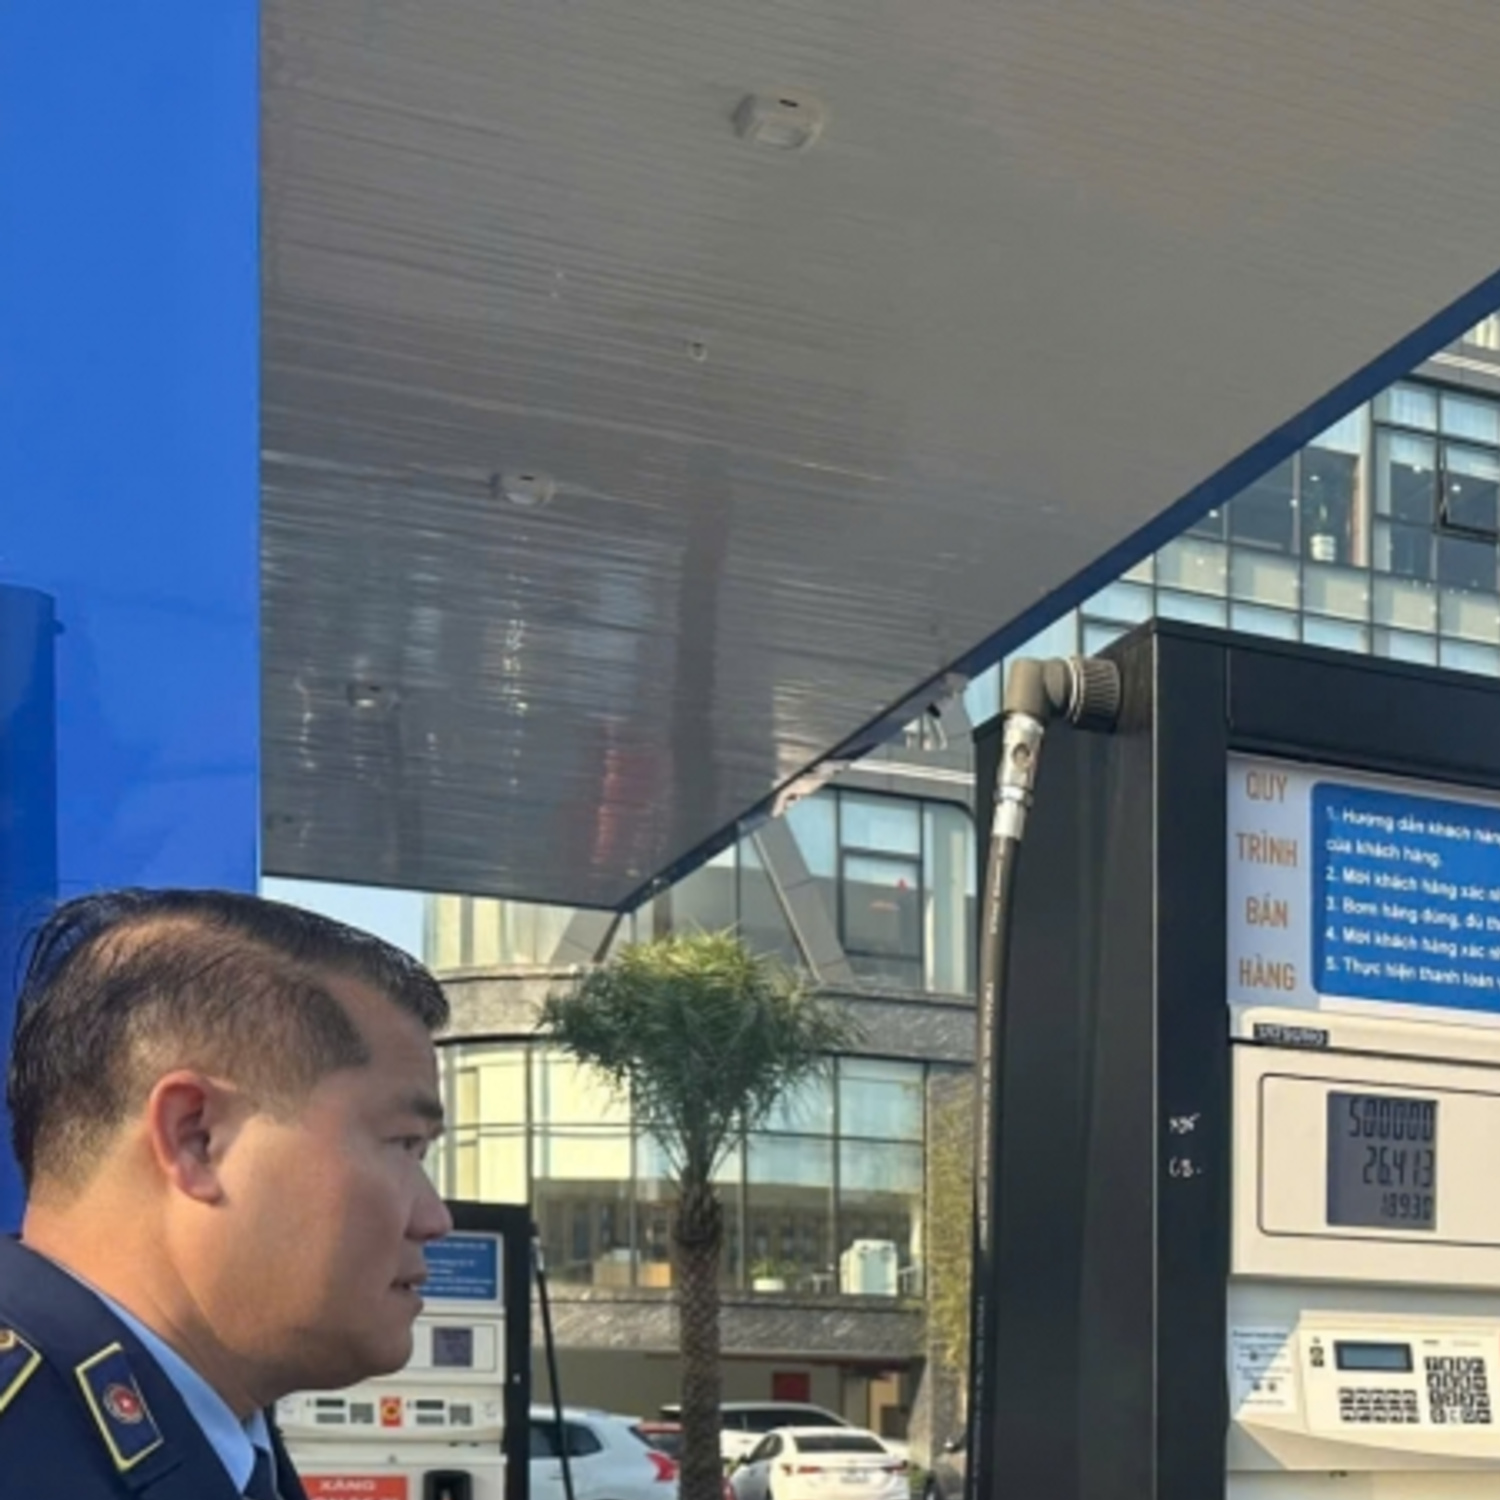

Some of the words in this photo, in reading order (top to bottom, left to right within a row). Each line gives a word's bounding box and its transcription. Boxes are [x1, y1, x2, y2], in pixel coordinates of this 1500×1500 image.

[1246, 771, 1288, 803] QUY
[1428, 821, 1471, 841] khách
[1236, 830, 1298, 867] TRÌNH
[1356, 839, 1400, 859] khách
[1326, 866, 1339, 881] 2.
[1342, 866, 1370, 886] Mời
[1373, 871, 1417, 891] khách
[1421, 877, 1457, 900] hàng
[1460, 883, 1485, 901] xác
[1246, 893, 1288, 928] BÁN
[1382, 900, 1417, 924] hàng
[1326, 926, 1339, 941] 4.
[1342, 926, 1370, 945] Mời
[1374, 931, 1417, 951] khách
[1422, 936, 1457, 958] hàng
[1460, 943, 1485, 959] xác
[1239, 953, 1296, 991] HÀNG
[1343, 956, 1380, 977] Thực
[1420, 966, 1460, 985] thanh
[1463, 971, 1494, 989] toán
